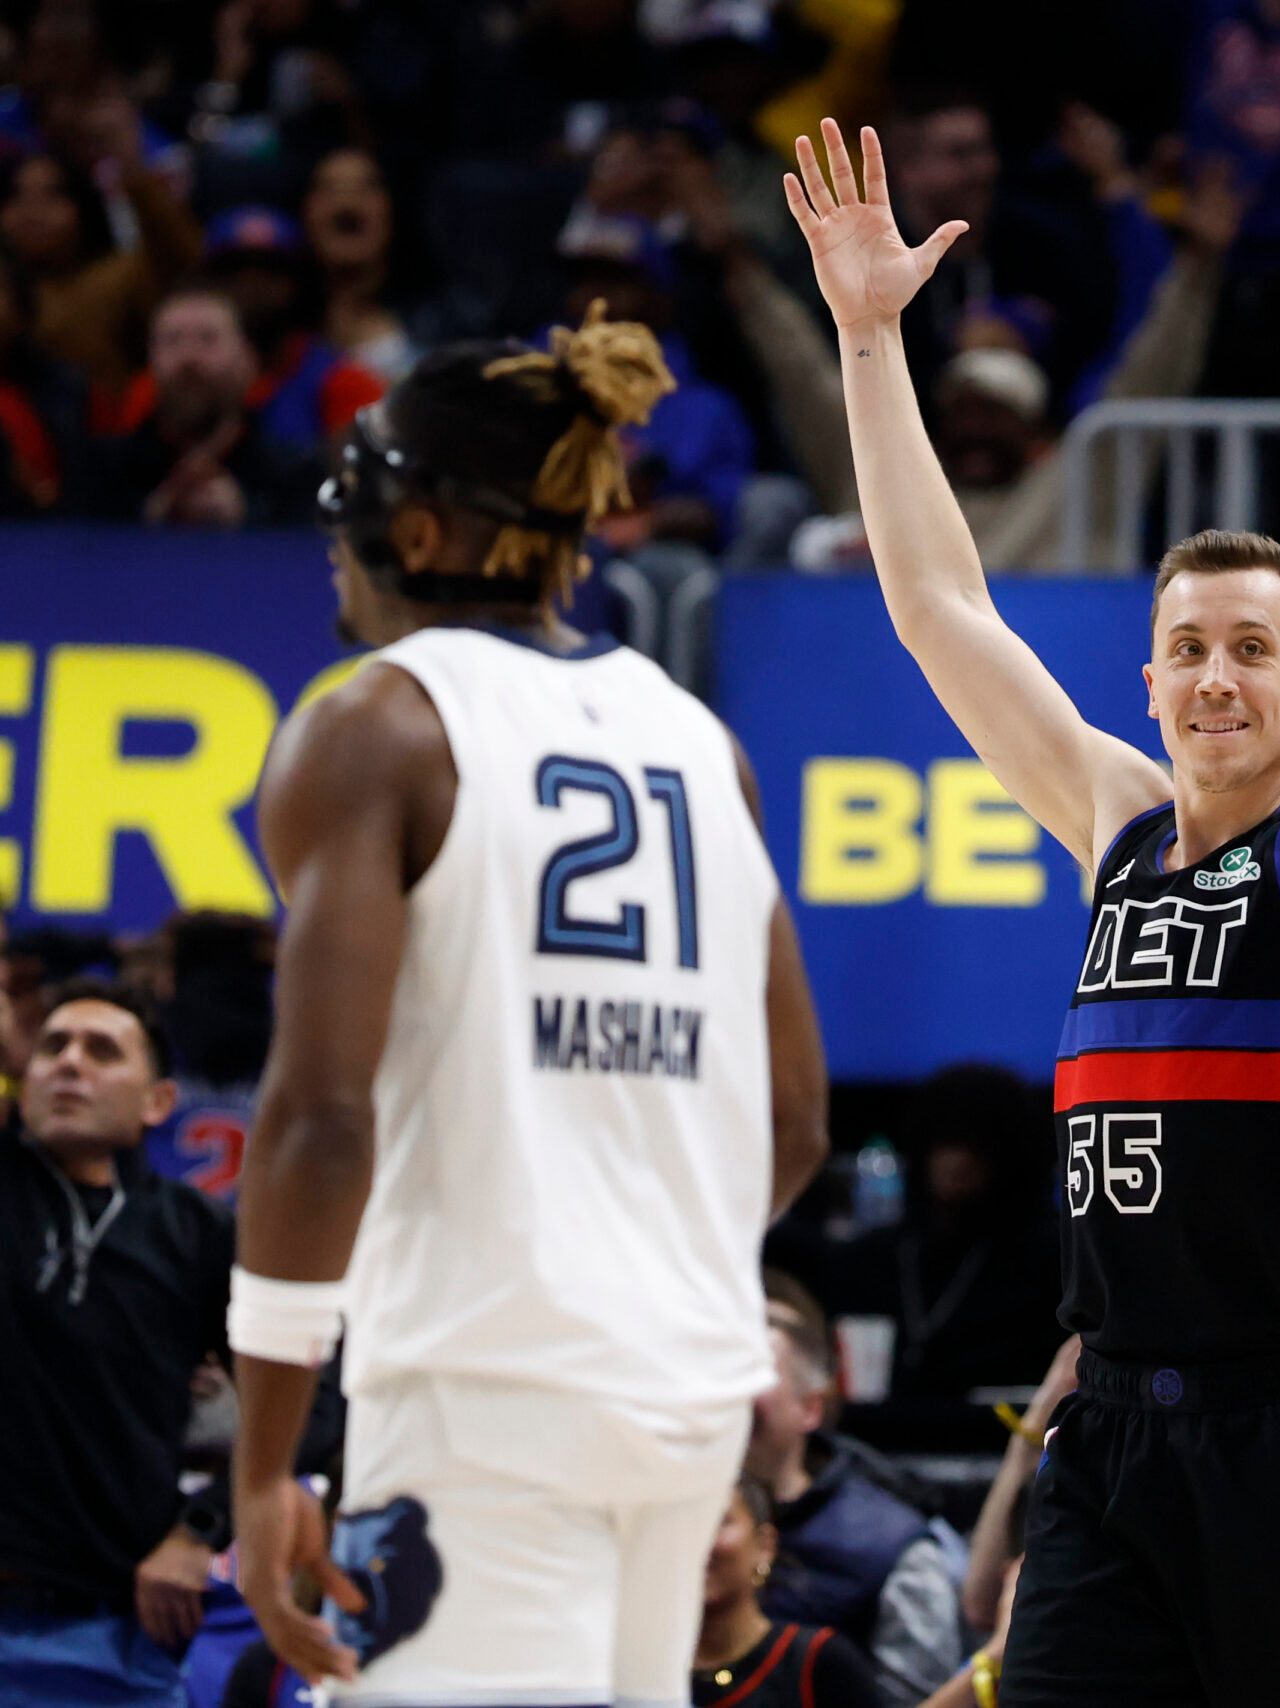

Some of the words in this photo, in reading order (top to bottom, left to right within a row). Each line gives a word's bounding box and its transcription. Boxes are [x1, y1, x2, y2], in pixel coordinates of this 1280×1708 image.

[537, 755, 699, 969] 21
[1077, 896, 1248, 993] DET
[1067, 1113, 1162, 1218] 55
